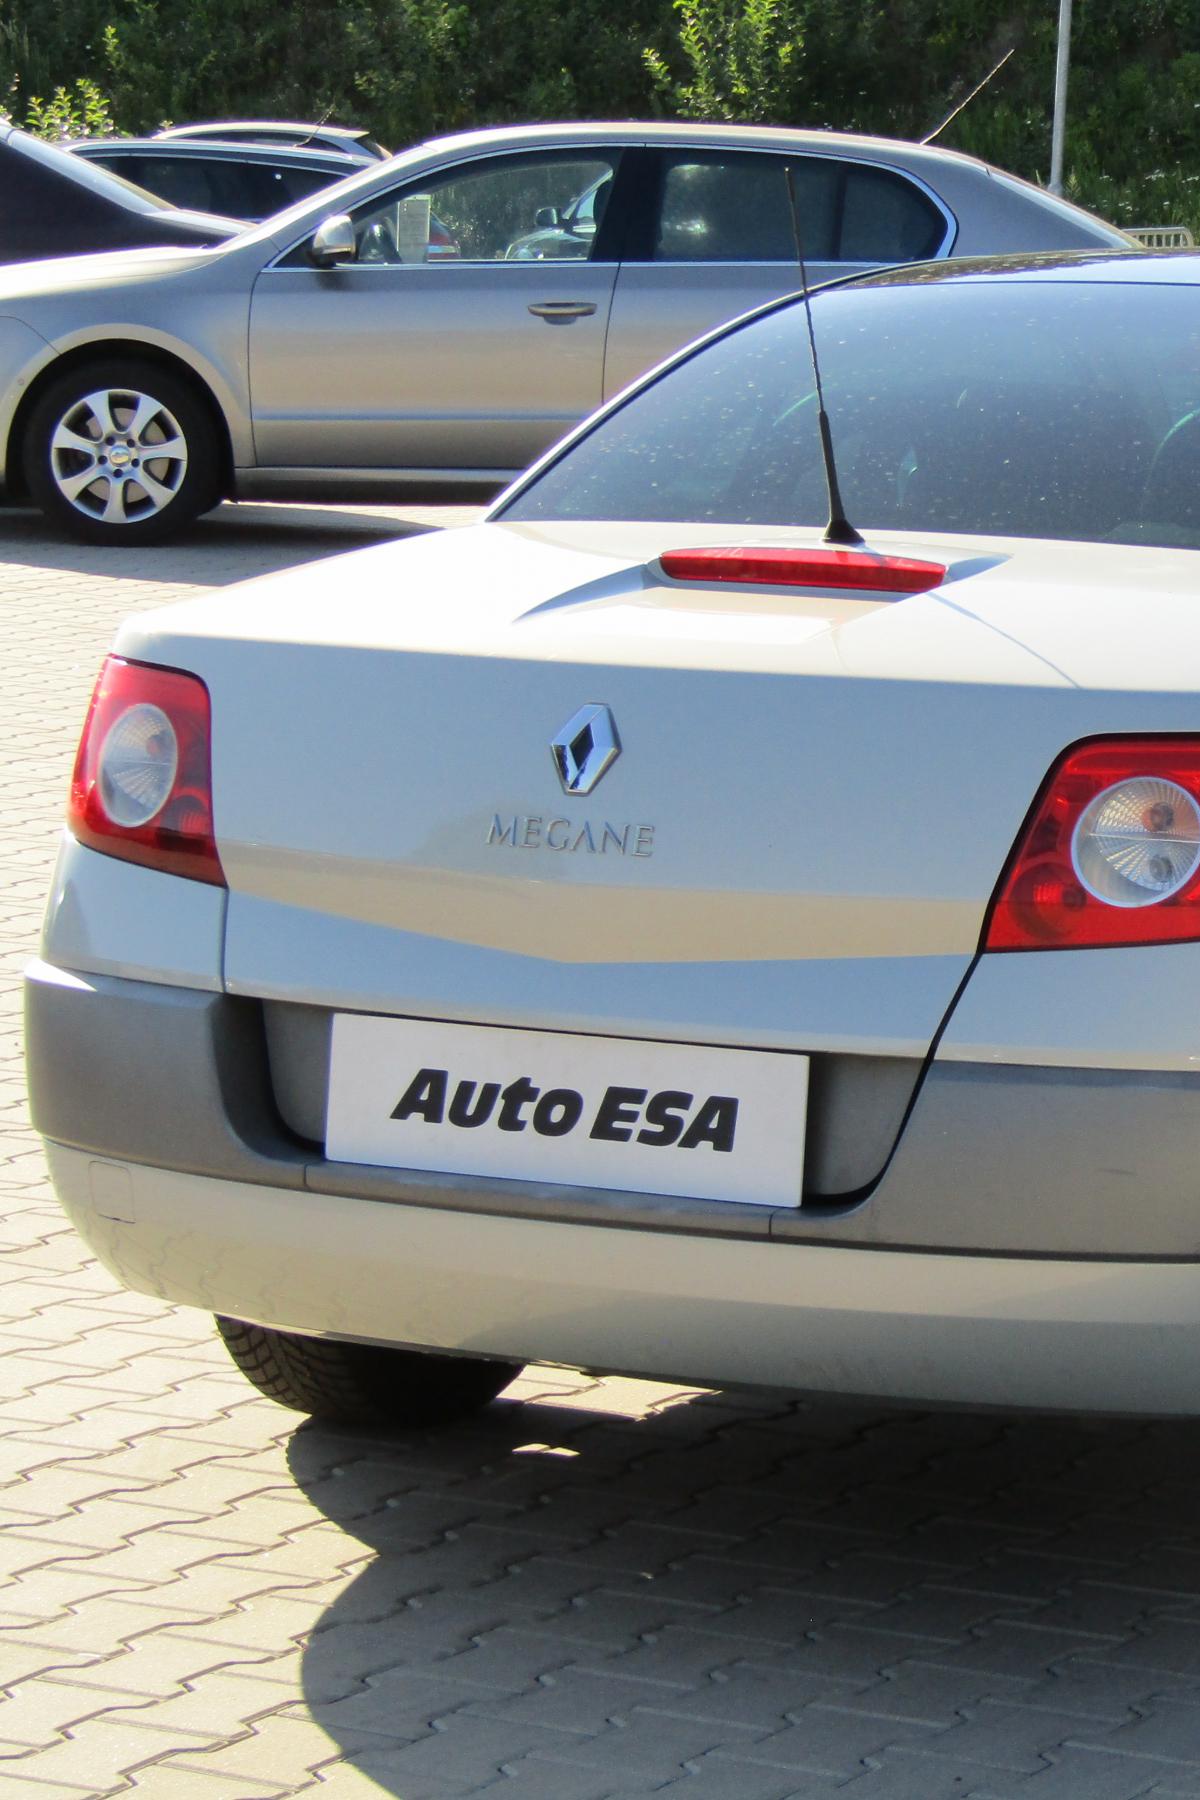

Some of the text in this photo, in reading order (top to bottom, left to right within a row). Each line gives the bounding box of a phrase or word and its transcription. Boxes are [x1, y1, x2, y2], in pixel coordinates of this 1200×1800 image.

[485, 813, 655, 857] MEGANE
[390, 1068, 739, 1152] Auto ESA
